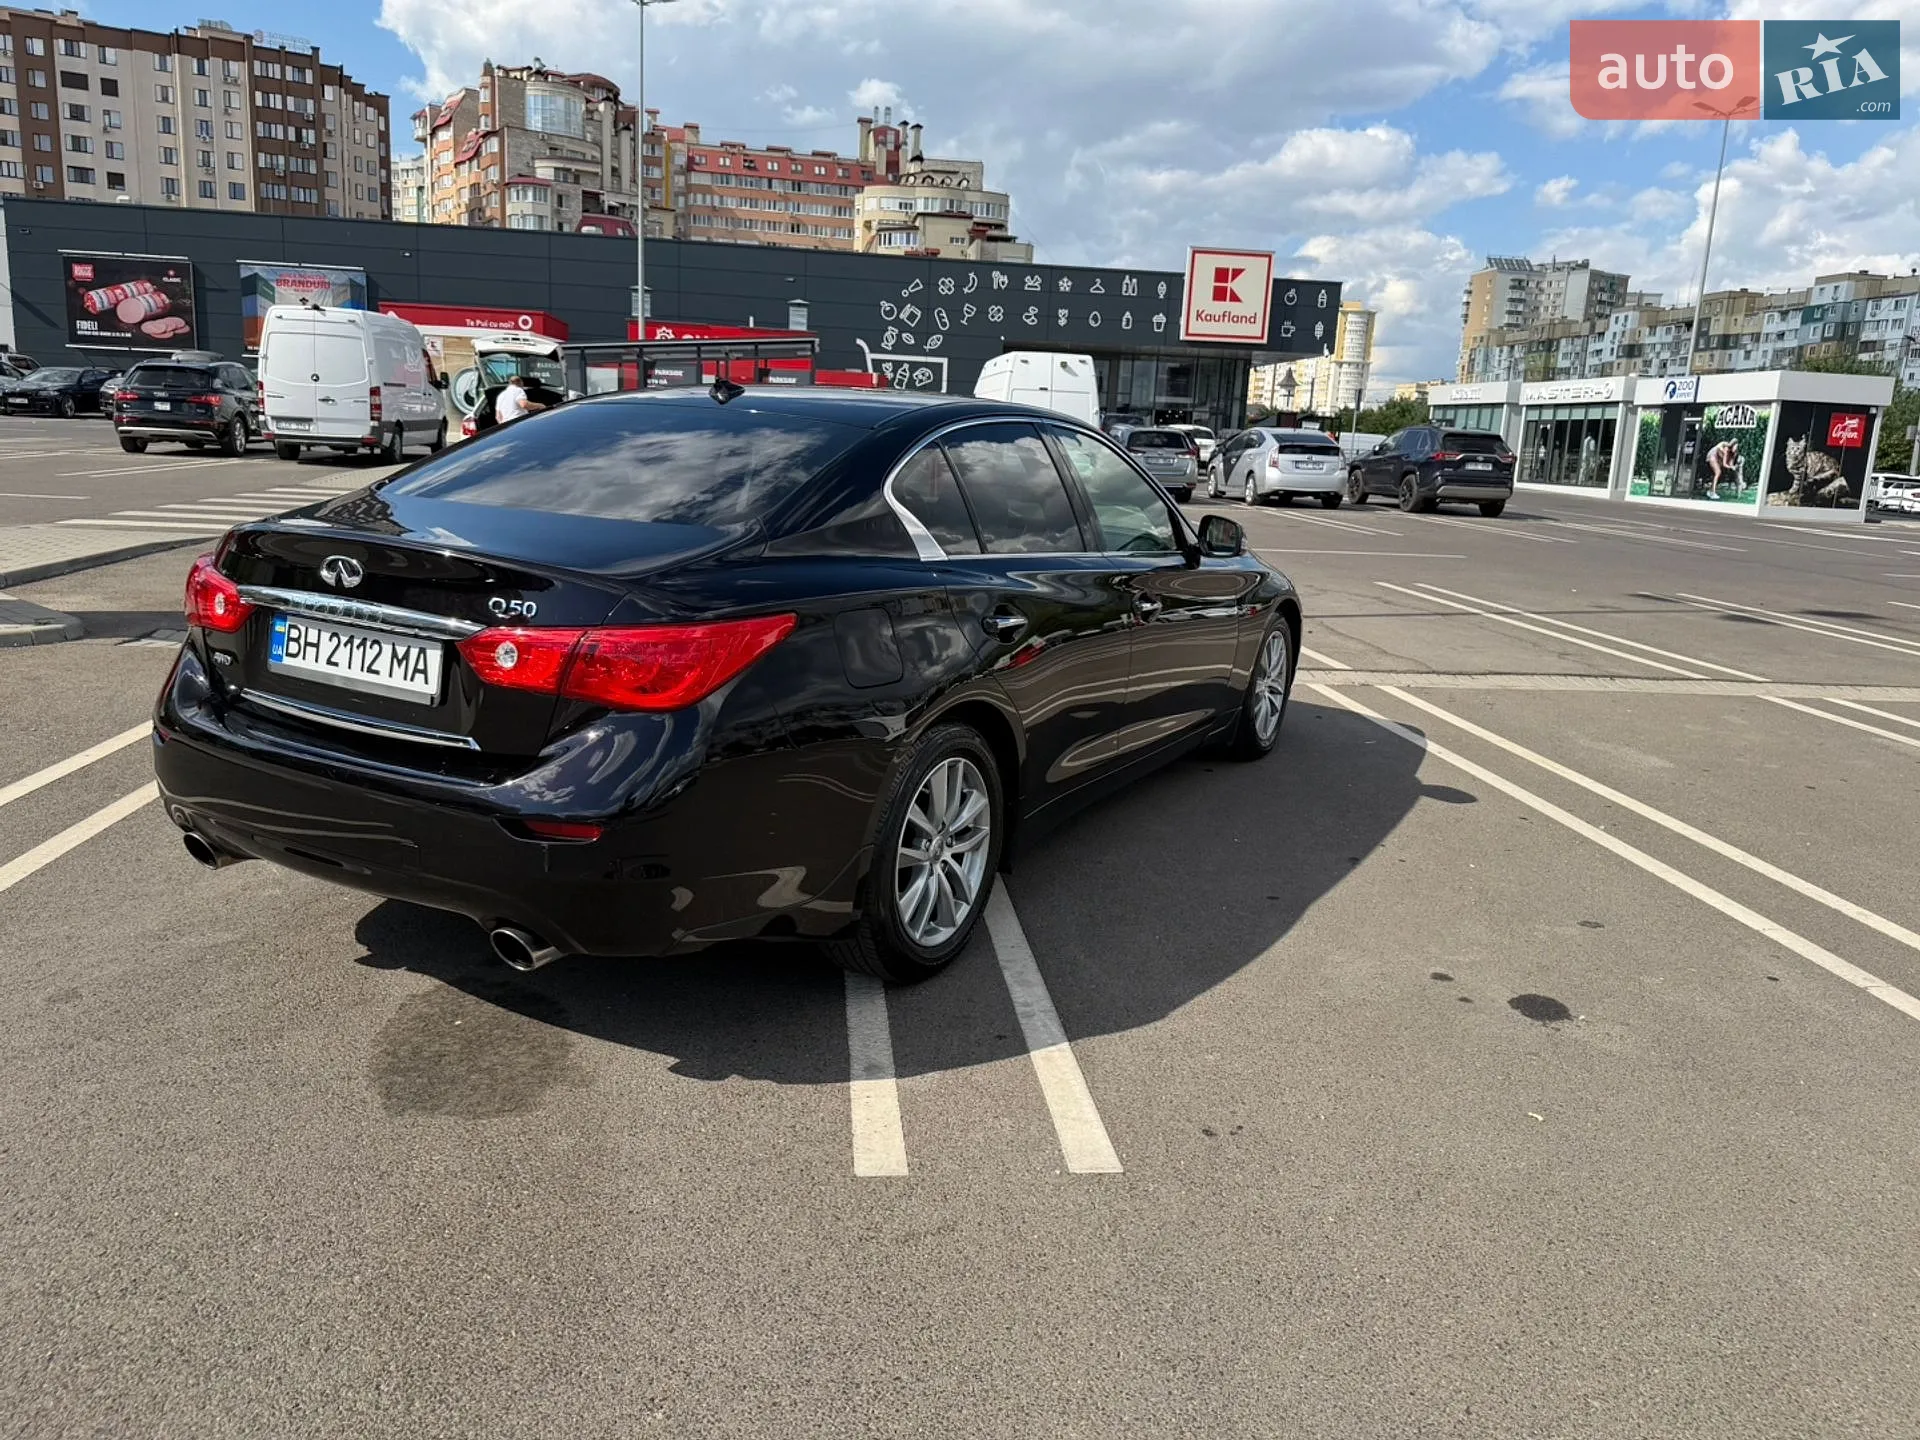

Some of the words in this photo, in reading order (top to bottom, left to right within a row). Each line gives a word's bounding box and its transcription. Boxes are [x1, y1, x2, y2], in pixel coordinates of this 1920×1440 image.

[275, 278, 331, 290] BRANDURI
[1195, 308, 1258, 325] Kaufland
[1677, 379, 1695, 392] ZOO
[1716, 404, 1756, 427] ACANA
[487, 596, 538, 619] Q50
[286, 622, 320, 664] BH
[326, 633, 383, 677] 2112
[388, 644, 430, 686] MA
